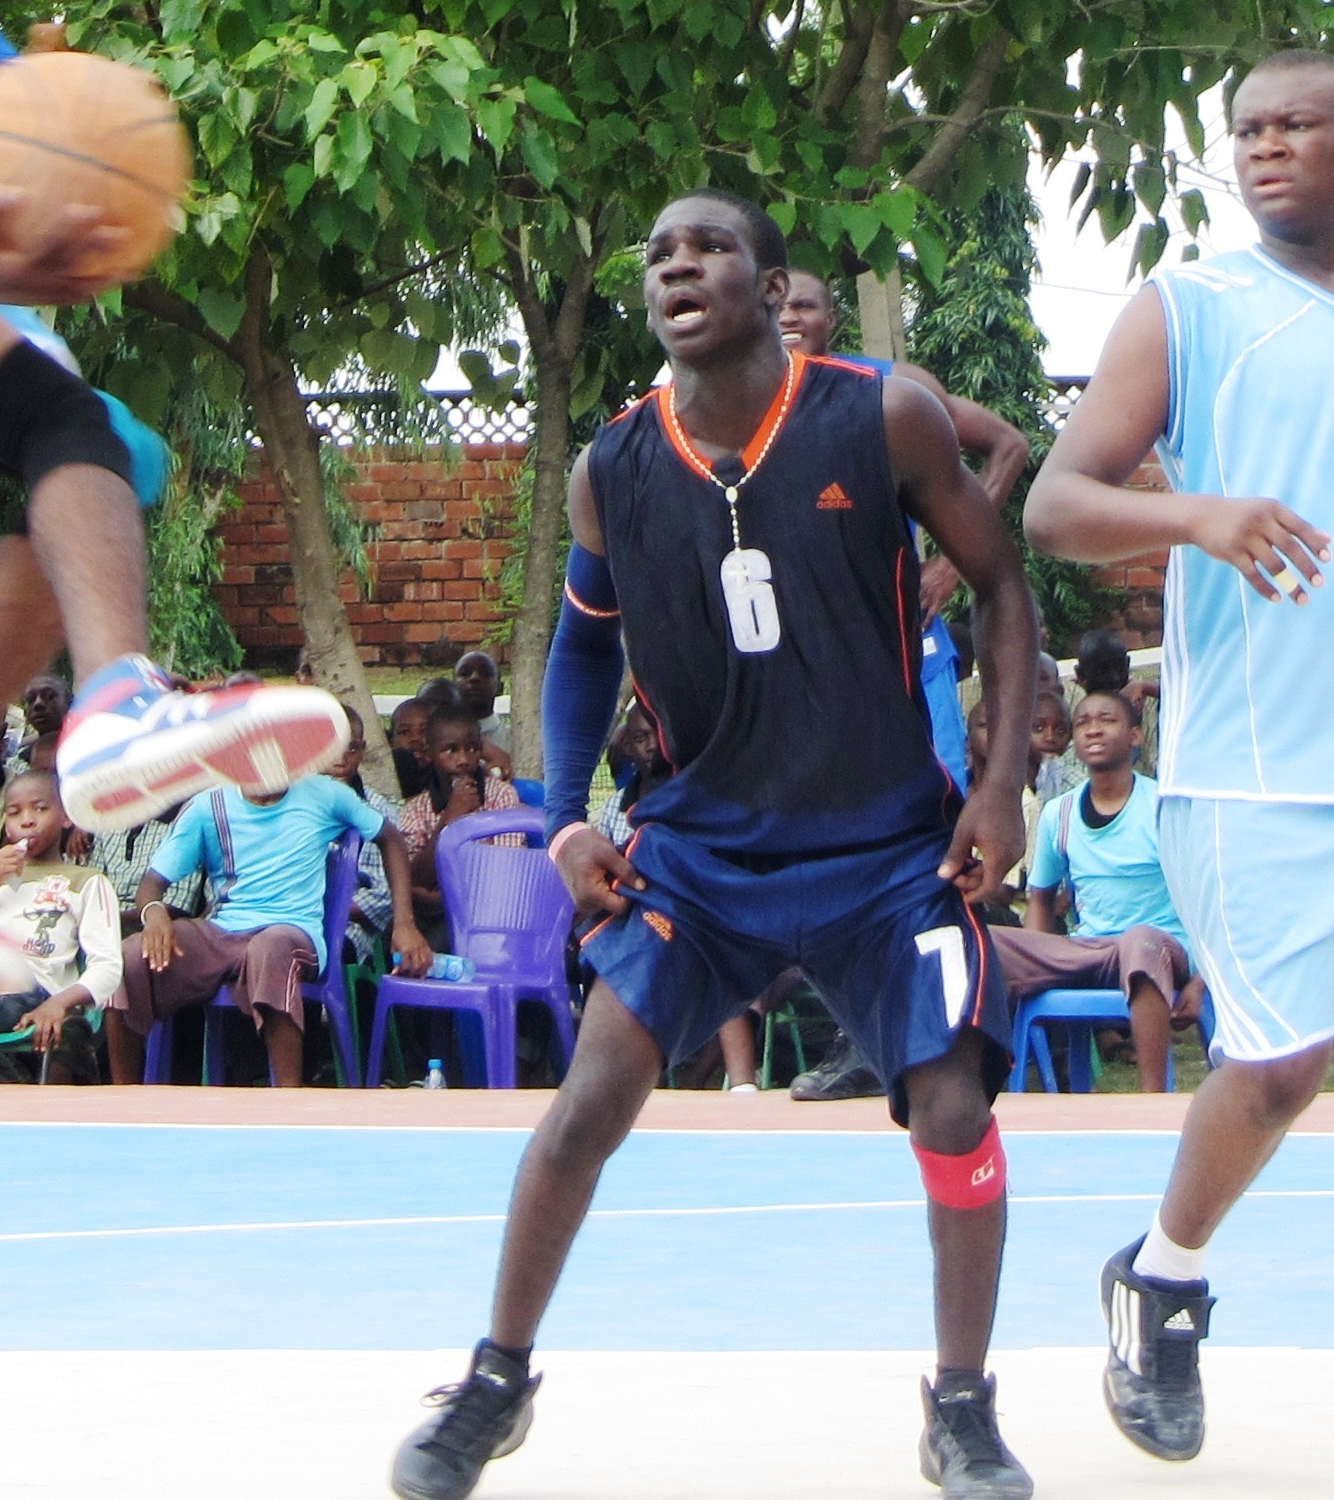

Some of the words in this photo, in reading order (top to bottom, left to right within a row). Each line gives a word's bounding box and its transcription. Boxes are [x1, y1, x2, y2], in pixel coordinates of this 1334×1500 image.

[815, 499, 854, 509] adidas
[720, 548, 781, 653] 6
[642, 911, 673, 941] adidas
